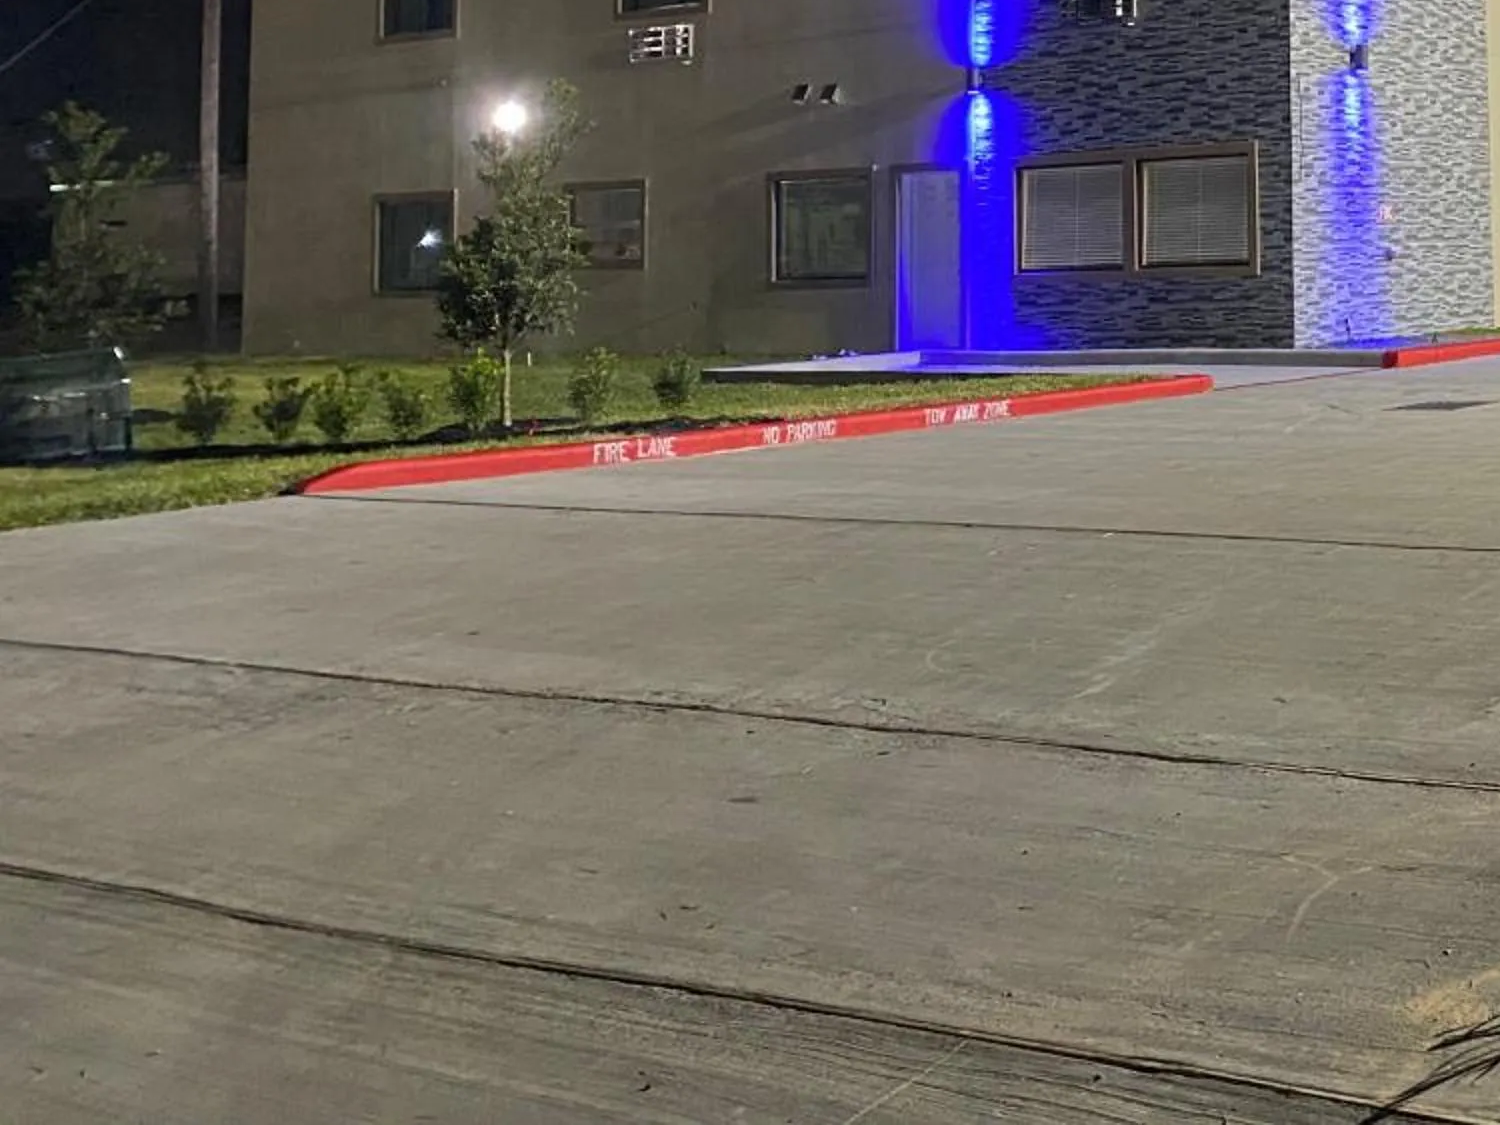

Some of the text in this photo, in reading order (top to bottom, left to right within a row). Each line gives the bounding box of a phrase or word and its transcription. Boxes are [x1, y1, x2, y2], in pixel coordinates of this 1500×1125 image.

[763, 419, 837, 444] NO PARKING
[593, 437, 677, 464] FIRE LANE
